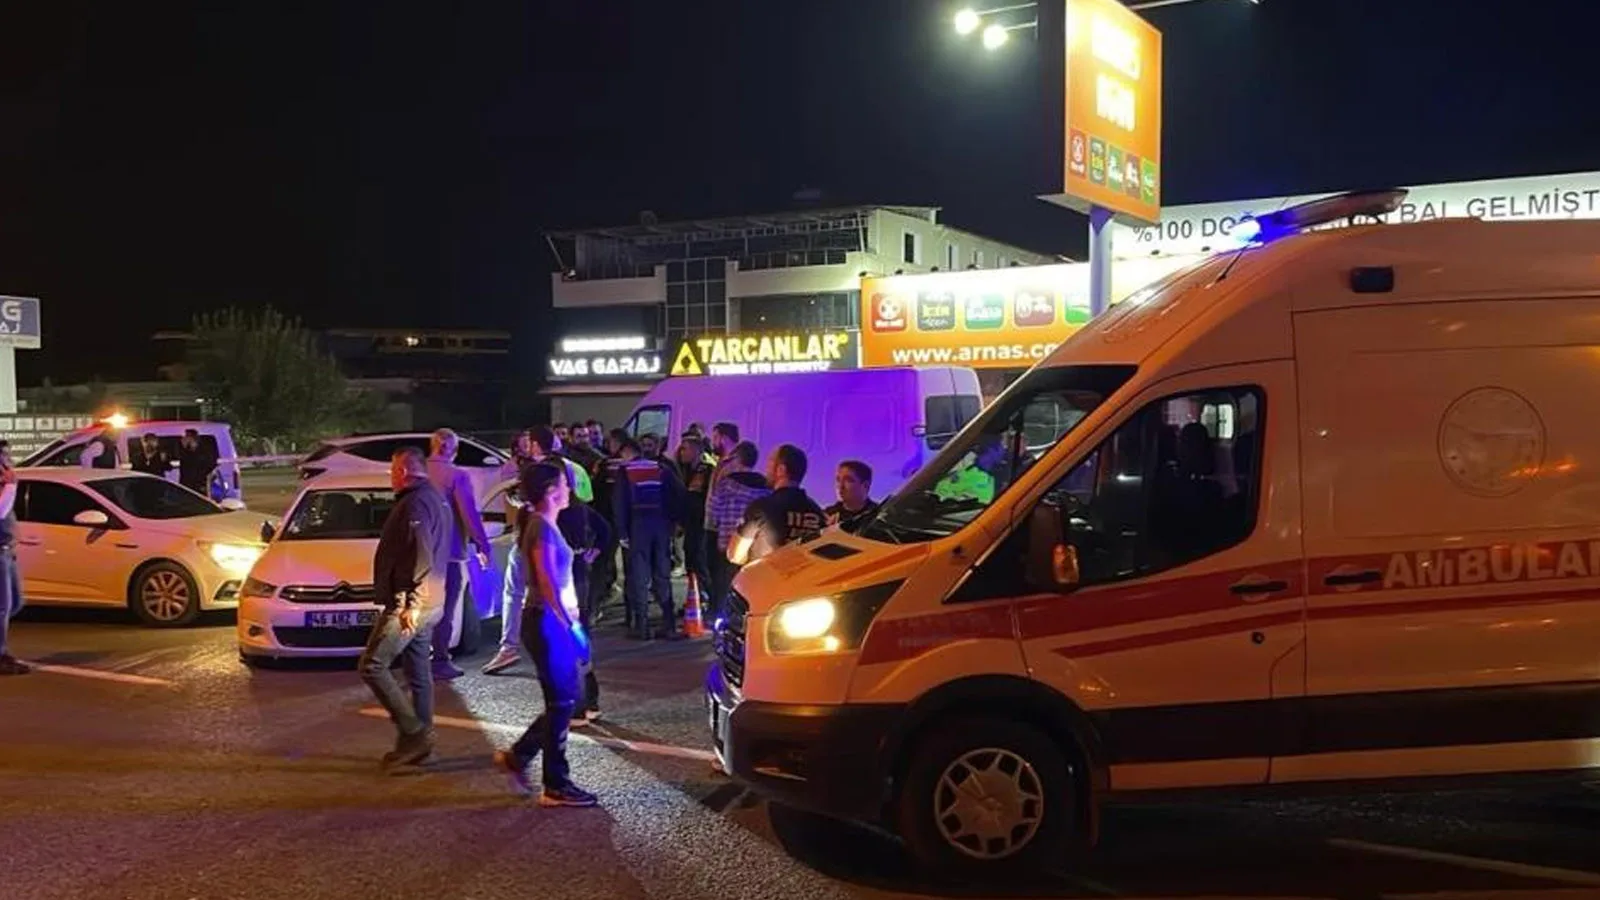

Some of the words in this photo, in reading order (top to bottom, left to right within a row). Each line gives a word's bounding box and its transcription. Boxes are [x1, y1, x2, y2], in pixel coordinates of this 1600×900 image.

[697, 334, 842, 363] TARCANLAR
[550, 358, 588, 375] VAG
[592, 356, 660, 374] GARAJ
